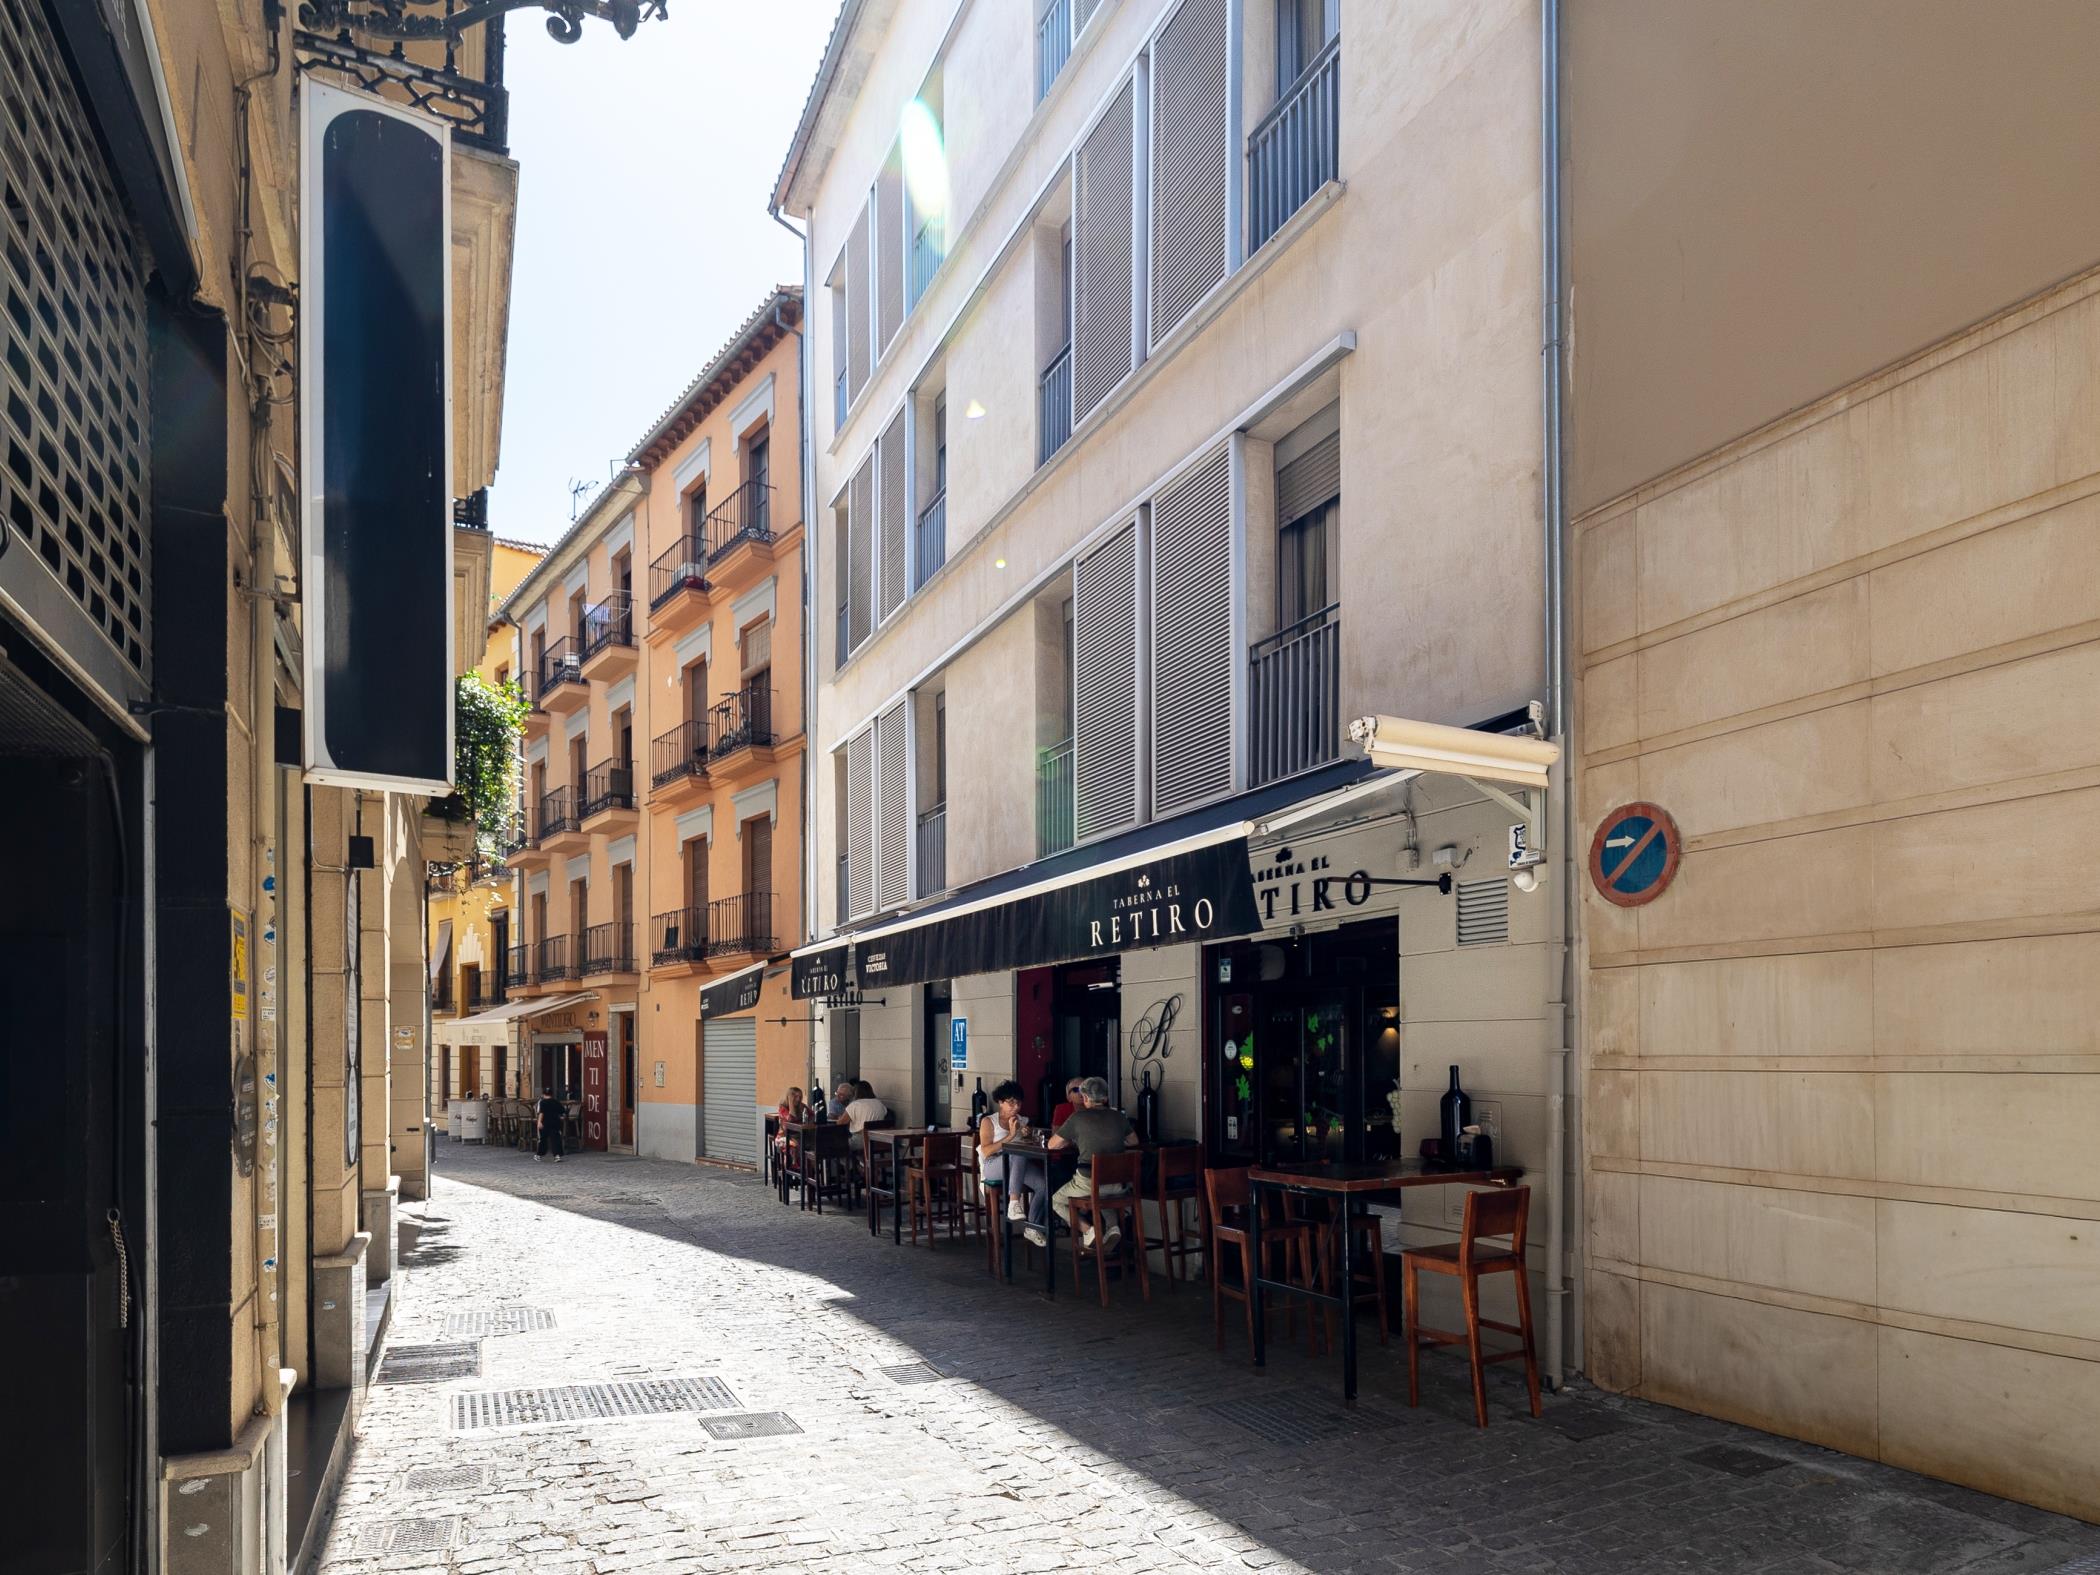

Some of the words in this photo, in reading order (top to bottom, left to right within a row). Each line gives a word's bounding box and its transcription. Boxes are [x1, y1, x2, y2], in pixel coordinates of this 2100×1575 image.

[1311, 856, 1330, 871] EL
[1113, 889, 1162, 910] TABERNA
[1167, 884, 1180, 898] EL
[1090, 898, 1213, 947] RETIRO
[865, 961, 888, 974] VICTORIA
[953, 1022, 965, 1042] AT
[584, 1039, 605, 1058] MEN
[589, 1067, 599, 1086] TI
[587, 1094, 600, 1113] DE
[588, 1122, 601, 1140] RO
